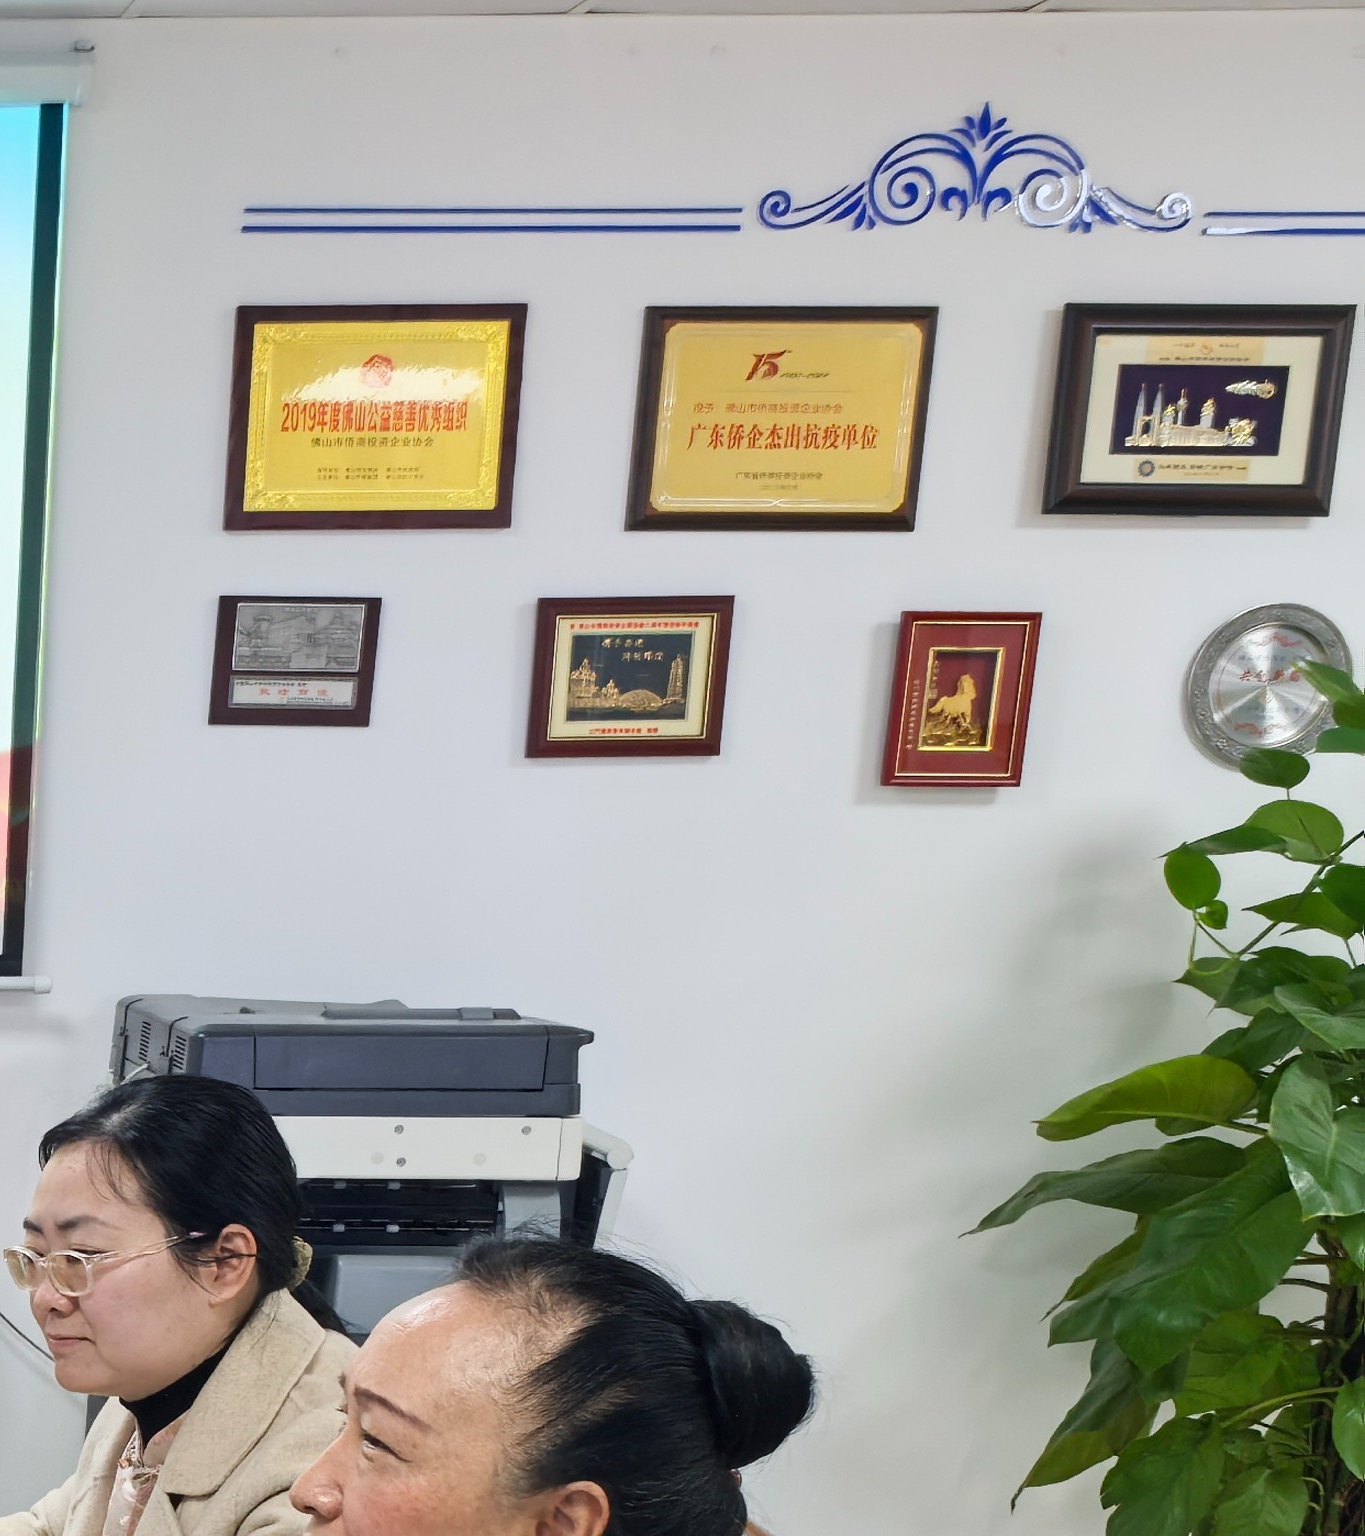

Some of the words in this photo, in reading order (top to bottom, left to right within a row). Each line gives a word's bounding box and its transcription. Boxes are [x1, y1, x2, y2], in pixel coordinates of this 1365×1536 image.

[280, 400, 469, 433] 2019年度佛山公益慈善优秀组织
[686, 422, 880, 451] 广东侨企杰出抗疫单位
